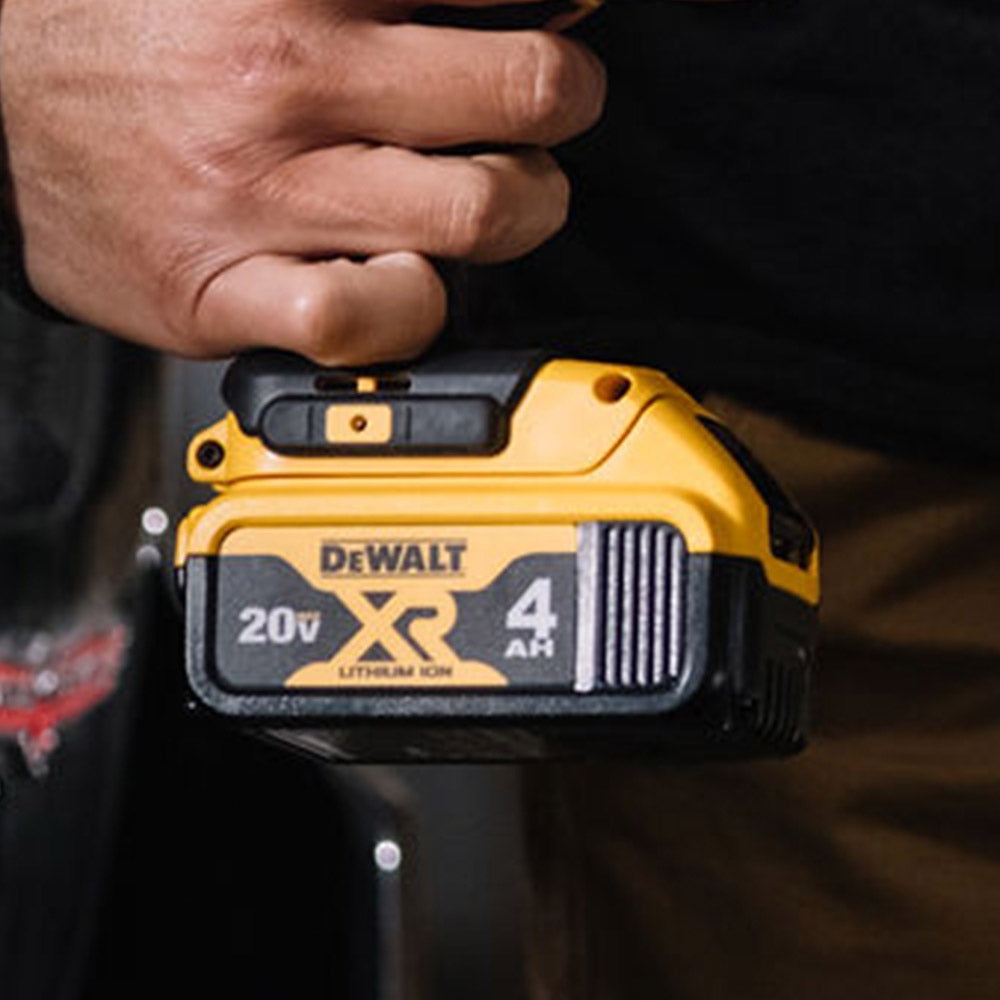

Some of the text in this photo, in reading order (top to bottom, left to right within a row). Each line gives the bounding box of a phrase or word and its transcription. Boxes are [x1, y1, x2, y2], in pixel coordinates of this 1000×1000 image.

[330, 589, 461, 663] XR
[504, 576, 558, 638] 4
[338, 667, 453, 679] LITHIUM ION
